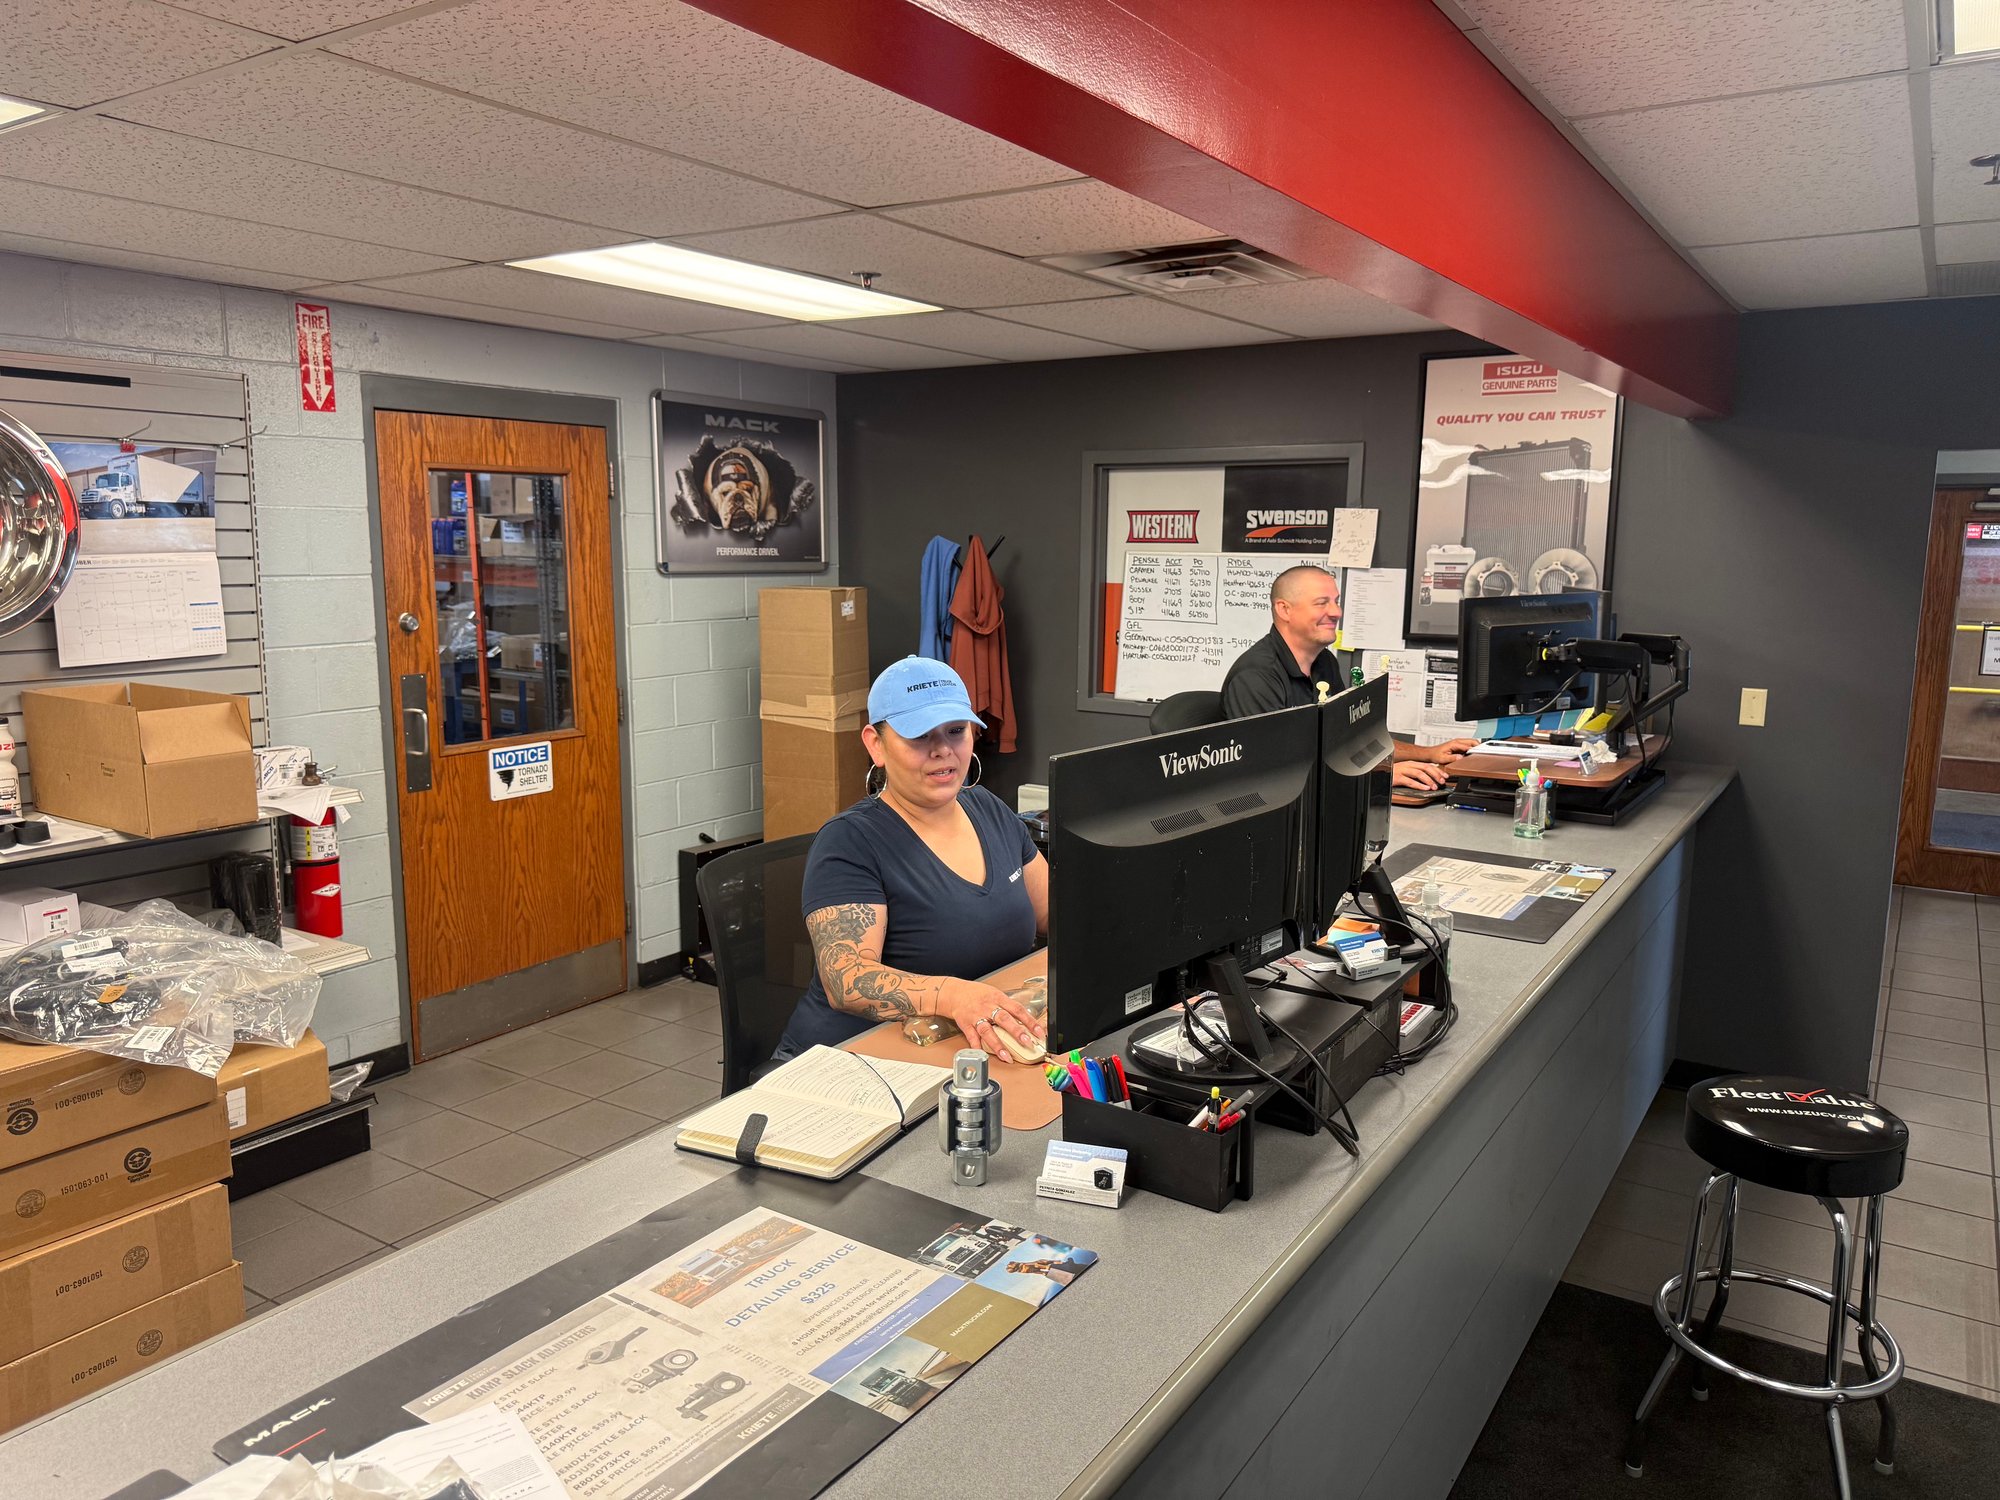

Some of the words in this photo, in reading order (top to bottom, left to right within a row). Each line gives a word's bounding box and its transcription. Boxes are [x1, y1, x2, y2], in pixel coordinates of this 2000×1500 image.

[302, 314, 325, 330] FIRE
[1496, 364, 1543, 376] ISUZU
[1482, 379, 1525, 391] GENUINE
[1526, 378, 1557, 389] PARTS
[704, 413, 781, 434] MACK
[1436, 413, 1494, 426] QUALITY
[1497, 412, 1524, 423] YOU
[1528, 411, 1556, 421] CAN
[1560, 409, 1606, 420] TRUST
[1132, 514, 1194, 540] WESTERN
[1246, 509, 1328, 529] Swenson
[716, 547, 758, 557] PERFORMANCE
[1132, 556, 1160, 564] PENSKE
[1193, 558, 1204, 566] PO
[1227, 558, 1253, 567] RYDER
[1129, 585, 1152, 593] SUSSEX
[1129, 595, 1145, 604] BODY
[1126, 620, 1142, 630] GFL
[906, 680, 939, 693] KRIETE
[1348, 695, 1371, 725] ViewSonic
[495, 747, 547, 768] NOTICE
[518, 764, 549, 777] TORNADO
[1159, 738, 1243, 779] ViewSonic
[519, 774, 548, 787] SHELTER
[60, 1172, 110, 1196] 1501063-001
[55, 1270, 104, 1297] 1501063-001
[725, 1279, 801, 1327] DETAILING
[799, 1243, 857, 1280] SERVICE
[744, 1259, 796, 1288] TRUCK
[795, 1327, 818, 1343] HOUR
[814, 1309, 844, 1329] INTERIOR
[846, 1287, 875, 1307] EXTERIOR
[872, 1268, 902, 1289] CLEANING
[800, 1282, 836, 1304] $325
[802, 1295, 844, 1324] EXPERIENCED
[841, 1278, 870, 1297] DETAILER
[795, 1343, 816, 1357] CALL
[855, 1306, 869, 1316] ask
[865, 1300, 877, 1308] for
[875, 1285, 899, 1301] service
[903, 1268, 922, 1281] email
[950, 1304, 993, 1337] MACKTRUCKS.COM
[70, 1355, 119, 1385] 1501063-001
[466, 1377, 501, 1400] KAMP
[501, 1357, 540, 1379] SLACK
[537, 1325, 596, 1359] ADJUSTERS
[423, 1378, 470, 1407] KRIETE
[498, 1383, 529, 1402] STYLE
[527, 1366, 558, 1385] SLACK
[516, 1393, 545, 1415] 44KTP
[519, 1405, 547, 1423] RICE:
[546, 1386, 577, 1406] $59.99
[541, 1408, 572, 1428] STYLE
[570, 1390, 601, 1410] SLACK
[243, 1397, 335, 1449] MACK
[559, 1430, 593, 1452] PRICE:
[591, 1410, 625, 1431] $59.99
[589, 1433, 619, 1454] STYLE
[617, 1414, 648, 1435] SLACK
[737, 1411, 777, 1440] KRIETE
[563, 1450, 612, 1485] ADJUSTER
[573, 1450, 630, 1490] R801073KTP
[583, 1478, 609, 1497] SALE
[607, 1457, 642, 1480] PRICE:
[640, 1436, 671, 1458] $59.99
